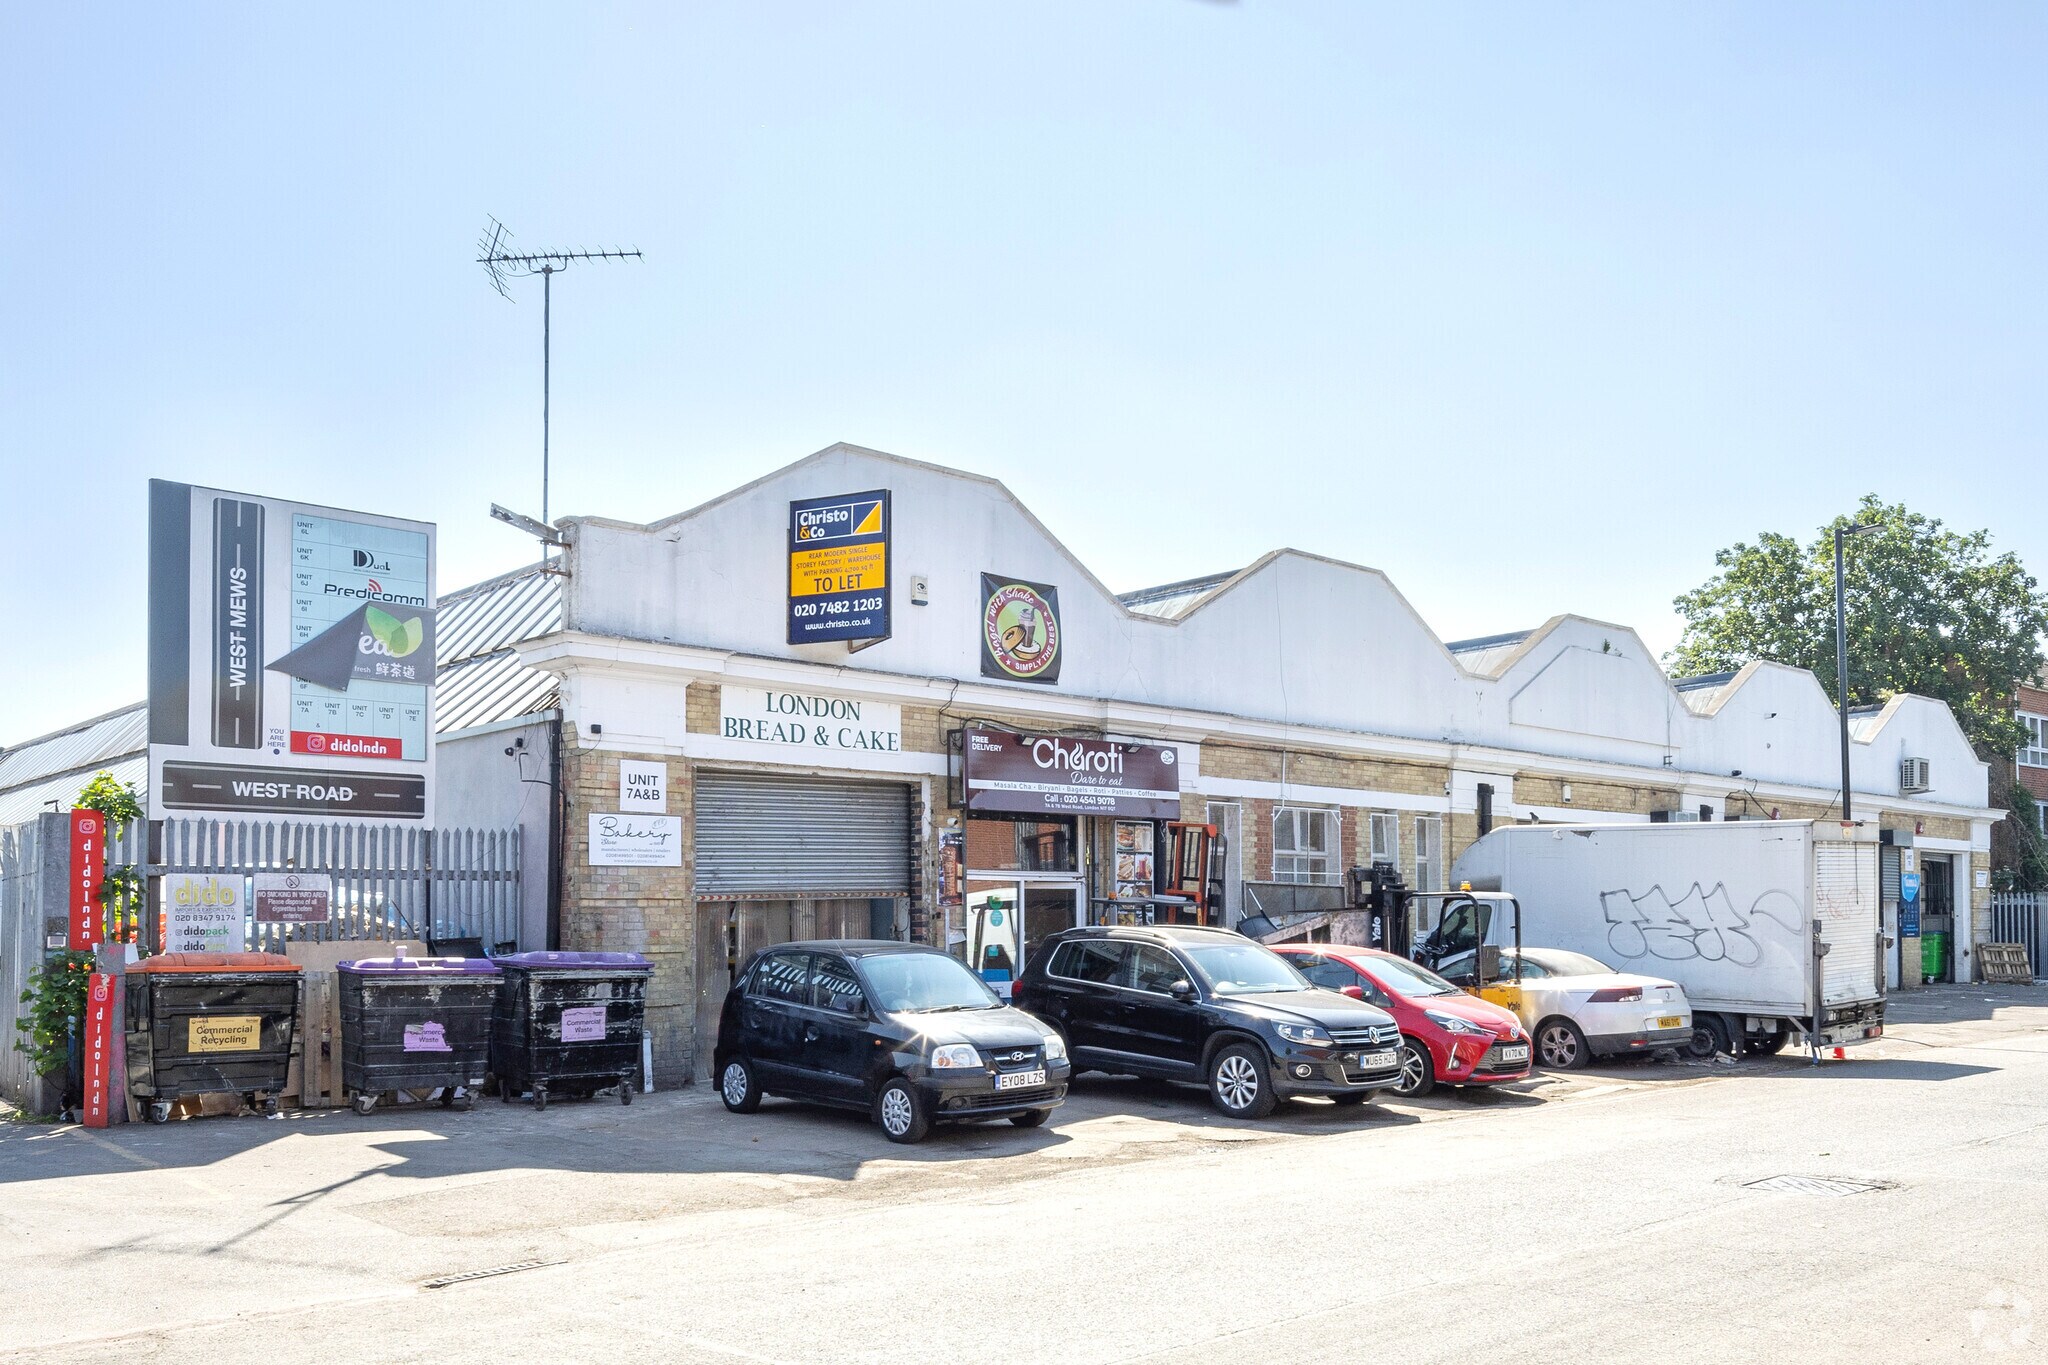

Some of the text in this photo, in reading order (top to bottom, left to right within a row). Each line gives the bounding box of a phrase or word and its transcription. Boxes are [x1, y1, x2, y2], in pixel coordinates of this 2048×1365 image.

[800, 510, 848, 526] Christo
[800, 526, 825, 540] &Co
[849, 546, 868, 554] SINGLE
[796, 562, 816, 570] STOREY
[818, 558, 842, 567] FACTORY
[848, 554, 881, 563] WAREHOUSE
[820, 567, 842, 575] PARKING
[814, 574, 862, 592] TO LET
[324, 584, 425, 606] Predicomm
[794, 597, 882, 617] 020 7482 1203
[230, 567, 248, 688] WEST MEWS
[805, 617, 870, 630] www.christo.co.uk
[1015, 620, 1055, 671] SIMPLY THE BEST
[354, 666, 371, 674] fresh
[766, 692, 862, 722] LONDON
[724, 716, 899, 752] BREAD & CAKE
[330, 738, 387, 755] didolndn
[972, 743, 1003, 752] DELIVERY
[1032, 737, 1123, 774] Charoti
[628, 774, 658, 786] UNIT
[1070, 771, 1123, 786] Dare to eat
[232, 781, 353, 802] WEST ROAD
[626, 788, 660, 800] 7A&B
[1038, 784, 1061, 792] Biryani
[1067, 786, 1088, 794] Bagels
[1044, 794, 1058, 802] Call
[1064, 795, 1078, 803] 020
[1080, 796, 1096, 804] 4541
[1097, 797, 1116, 805] 9078
[598, 816, 672, 846] Bakery
[82, 839, 91, 939] didolndn
[175, 877, 236, 908] dido
[184, 925, 230, 938] didopack
[1372, 916, 1381, 942] Yale
[196, 1025, 253, 1035] Commercial
[200, 1035, 247, 1045] Recycling
[92, 1007, 103, 1116] didolndn
[1002, 1072, 1044, 1087] EY08 LZS
